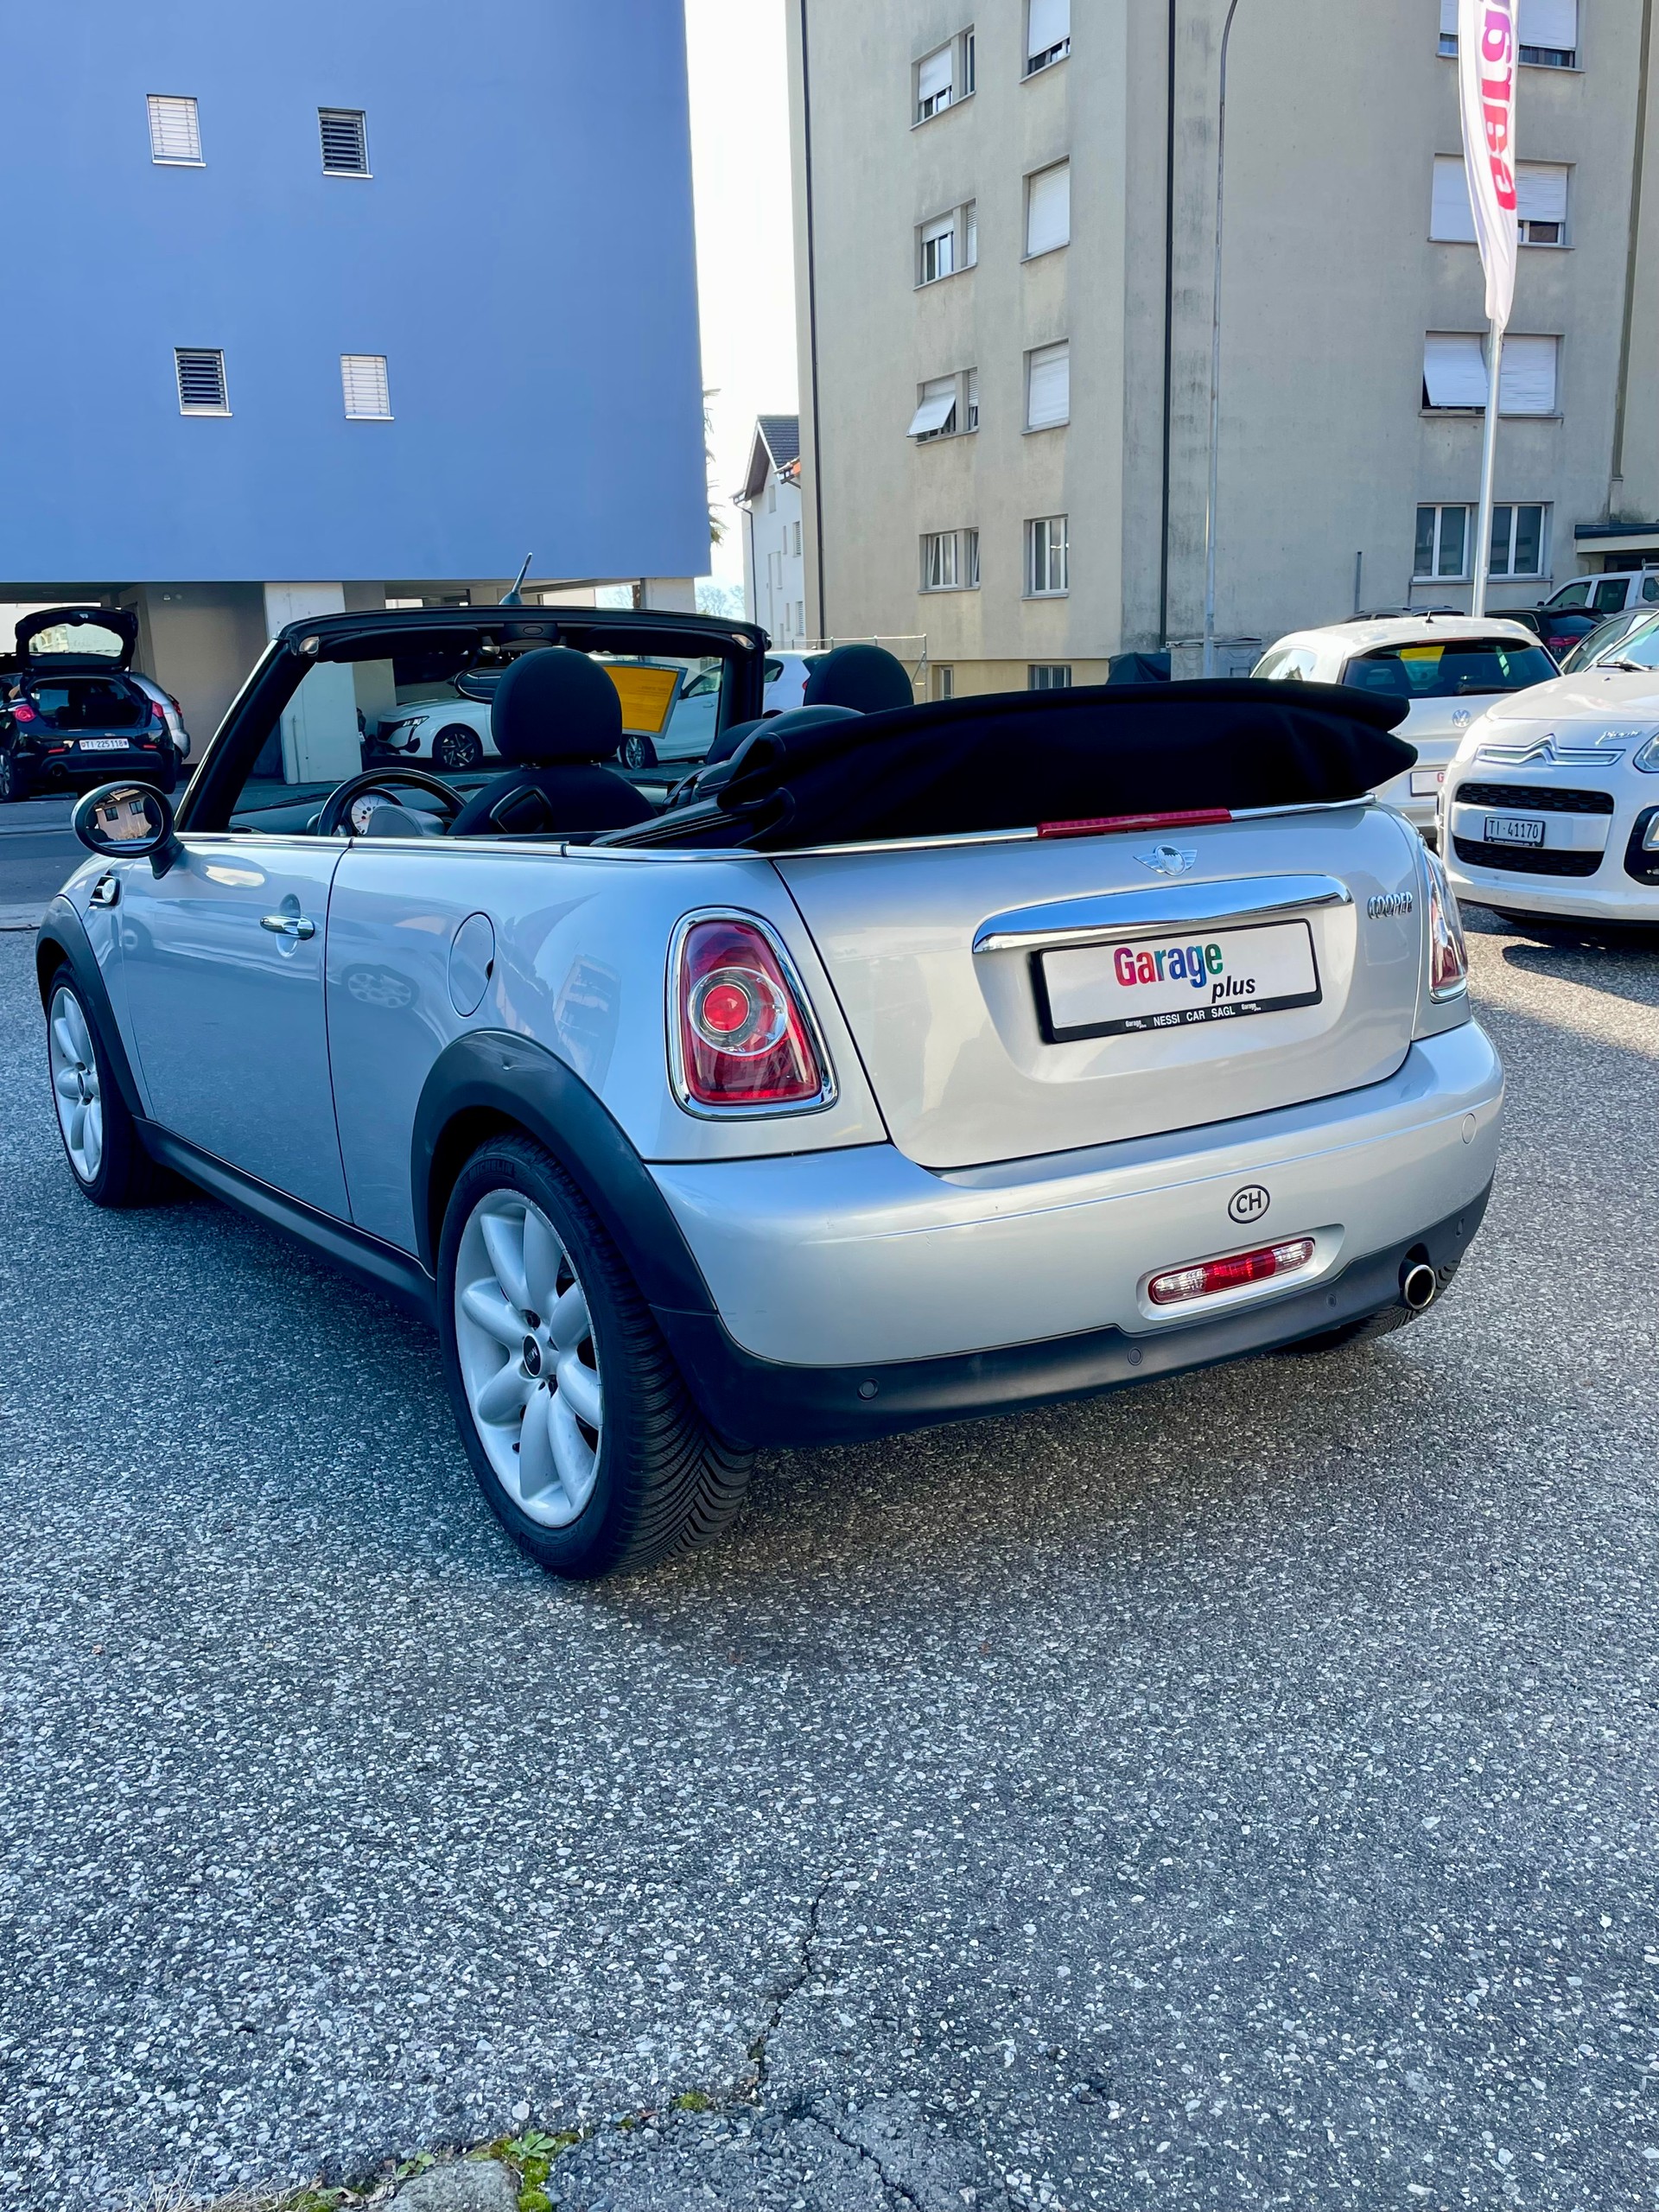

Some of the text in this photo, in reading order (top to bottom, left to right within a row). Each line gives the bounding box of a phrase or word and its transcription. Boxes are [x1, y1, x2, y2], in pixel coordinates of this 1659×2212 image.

[1367, 891, 1413, 919] COOPER
[1113, 943, 1224, 988] Garage
[1211, 976, 1255, 1004] plus
[1125, 1020, 1141, 1028] Garage
[1153, 1014, 1180, 1027] NESSI
[1186, 1010, 1205, 1022] CAR
[1211, 1006, 1236, 1018] SAGL
[1236, 1190, 1262, 1214] CH
